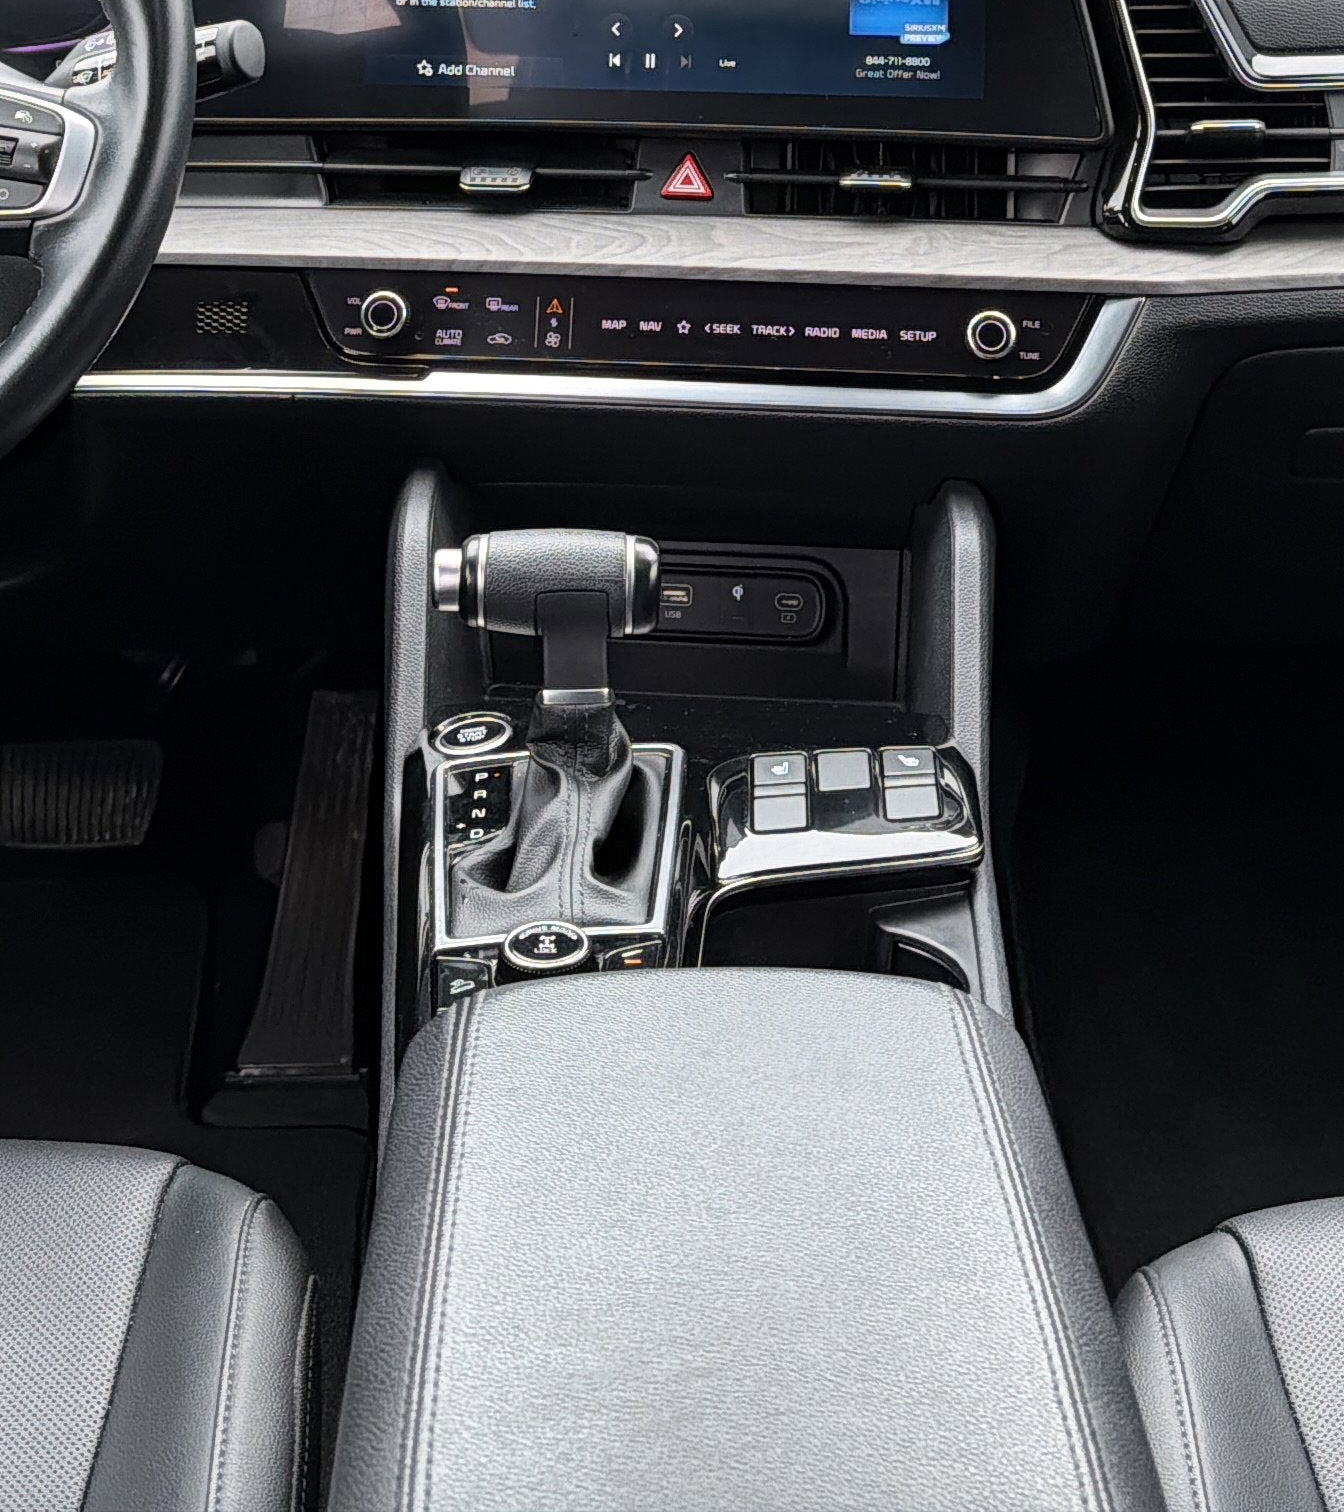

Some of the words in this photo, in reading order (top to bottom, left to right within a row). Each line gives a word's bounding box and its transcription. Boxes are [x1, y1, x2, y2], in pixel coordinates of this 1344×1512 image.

[904, 23, 946, 33] SIRIUSXM
[865, 56, 930, 66] 844-711-8800
[437, 63, 462, 76] Add
[465, 63, 516, 77] Channel
[856, 69, 884, 78] Great
[887, 70, 914, 79] Offer
[916, 70, 940, 80] Now!
[347, 297, 361, 305] VOL
[448, 302, 470, 310] FRONT
[501, 304, 519, 312] REAR
[601, 320, 627, 330] MAP
[639, 321, 662, 331] NAV
[1022, 320, 1040, 329] FILE
[344, 327, 362, 335] PWR
[436, 329, 462, 338] AUTO
[804, 327, 840, 338] RADIO
[851, 328, 887, 340] MEDIA
[899, 330, 937, 342] SETUP
[435, 338, 461, 346] CLIMATE
[1019, 351, 1040, 361] TUNE
[664, 611, 682, 619] USB
[475, 773, 488, 782] P
[474, 790, 487, 800] R
[472, 808, 485, 818] N
[470, 828, 484, 838] D
